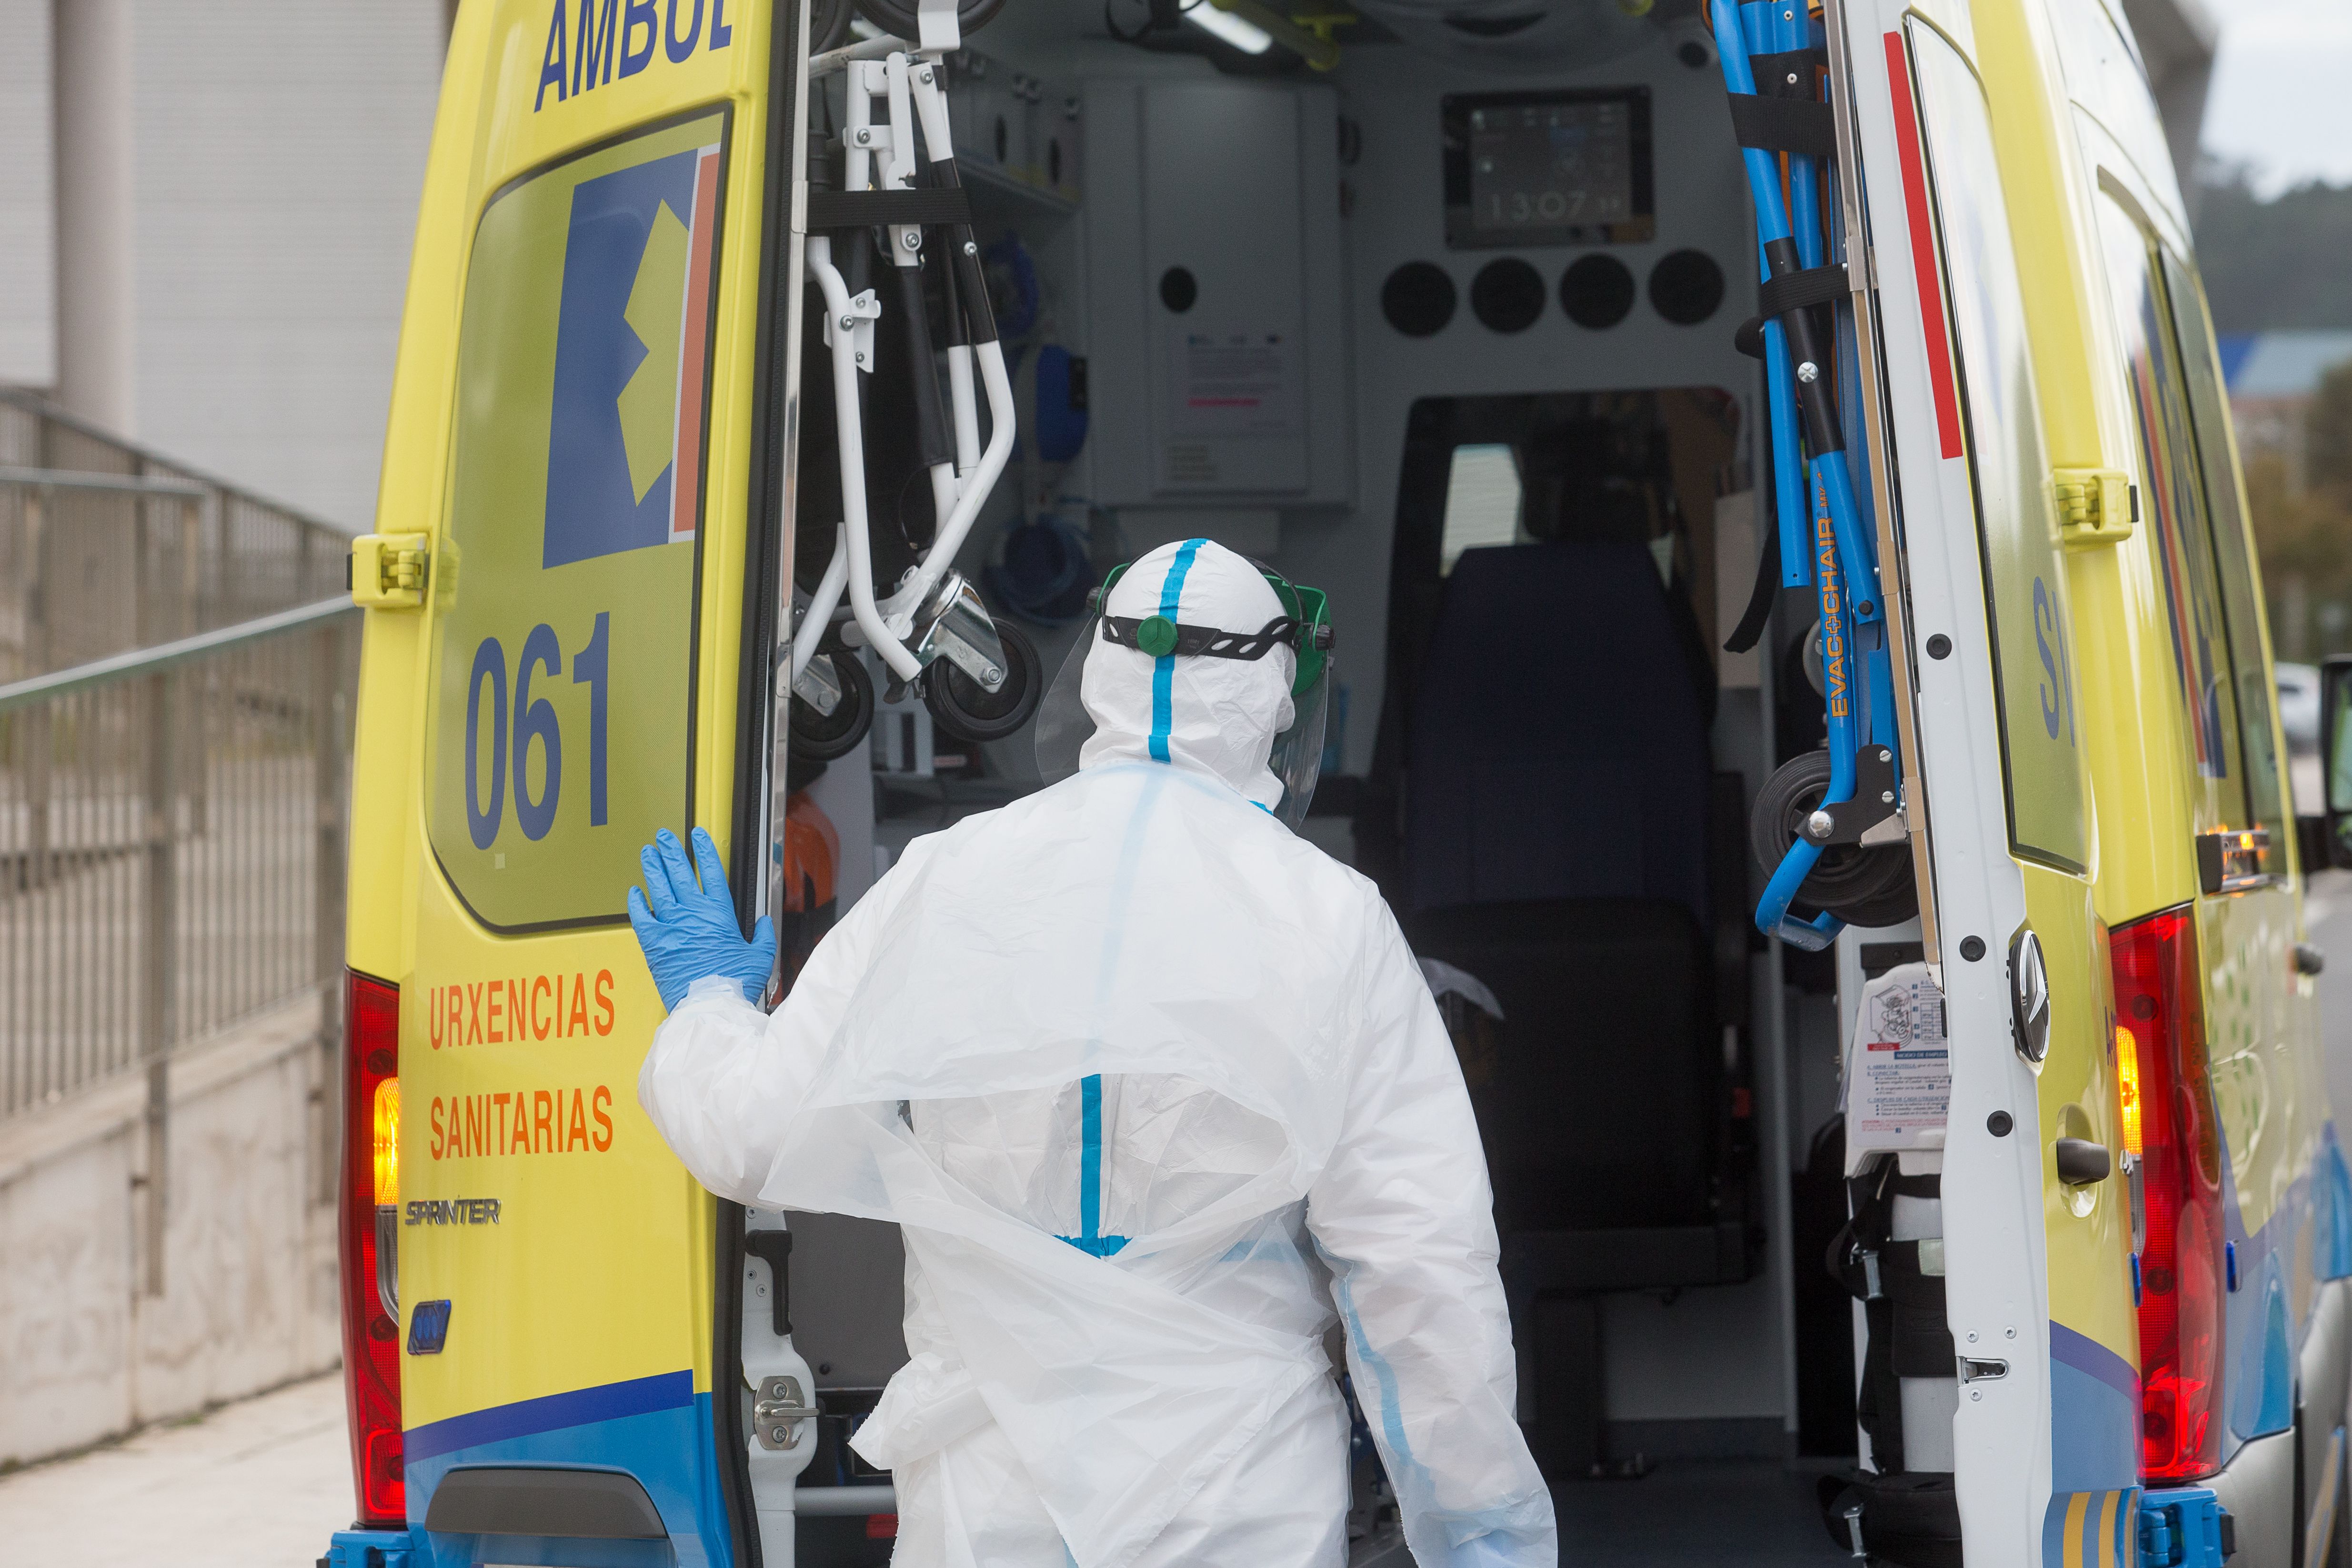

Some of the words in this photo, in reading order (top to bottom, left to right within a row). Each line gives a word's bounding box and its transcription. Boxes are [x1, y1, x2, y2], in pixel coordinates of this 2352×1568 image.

[465, 611, 610, 850] 061
[430, 969, 614, 1050] URXENCIAS
[430, 1085, 613, 1161] SANITARIAS
[405, 1198, 502, 1225] SPRINTER
